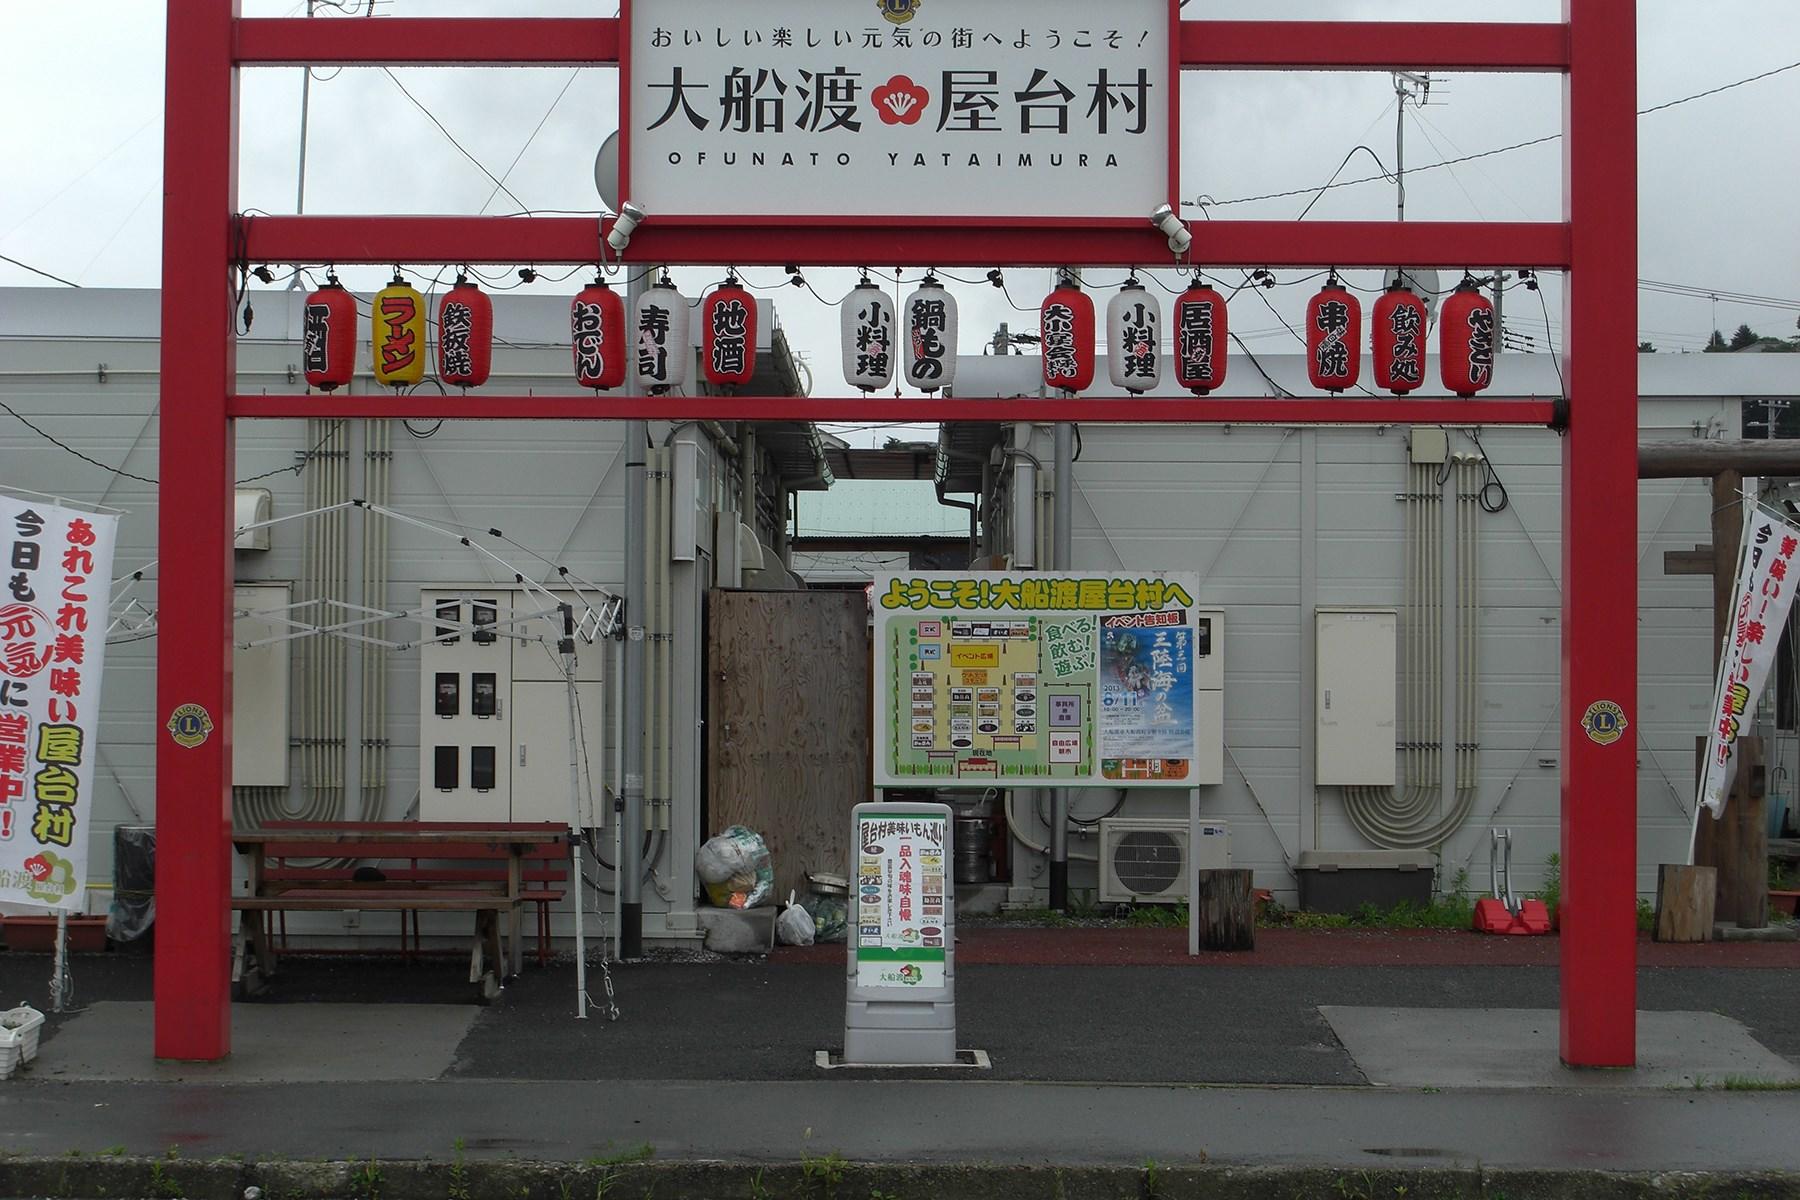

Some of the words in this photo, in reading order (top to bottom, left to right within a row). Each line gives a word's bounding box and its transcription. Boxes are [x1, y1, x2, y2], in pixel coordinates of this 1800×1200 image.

[651, 26, 1149, 49] おいしい楽しい元気の街へようこそ!
[646, 66, 862, 134] 大船渡
[936, 67, 1152, 135] 屋台村
[668, 151, 852, 167] OFUNATO
[887, 152, 1119, 168] YATAIMURA
[381, 296, 415, 375] ラーメン
[441, 303, 472, 377] 鉄板焼
[572, 301, 604, 381] おでん
[638, 304, 670, 381] 寿司
[713, 300, 748, 375] 地酒
[856, 301, 890, 378] 小料理
[911, 299, 946, 380] 鍋もの
[1122, 303, 1156, 378] 小料理
[1180, 301, 1213, 381] 居酒屋
[1316, 300, 1349, 378] 串焼
[1389, 303, 1421, 383] 飲み処
[1469, 308, 1494, 386] やきとり
[880, 578, 1194, 610] ようこそ!大船渡屋台村へ
[1045, 615, 1097, 643] 食べる!
[1104, 612, 1180, 628] イベント告知板
[32, 517, 97, 848] あれこれ美味い屋台村
[1048, 634, 1091, 660] 飲む!
[1053, 651, 1096, 678] 遊ぶ!
[1150, 631, 1178, 725] 三陸海の盆
[185, 717, 197, 732] L
[1592, 703, 1617, 712] LIONS
[1599, 714, 1611, 729] L
[861, 822, 945, 850] 屋台村美味いもん巡り
